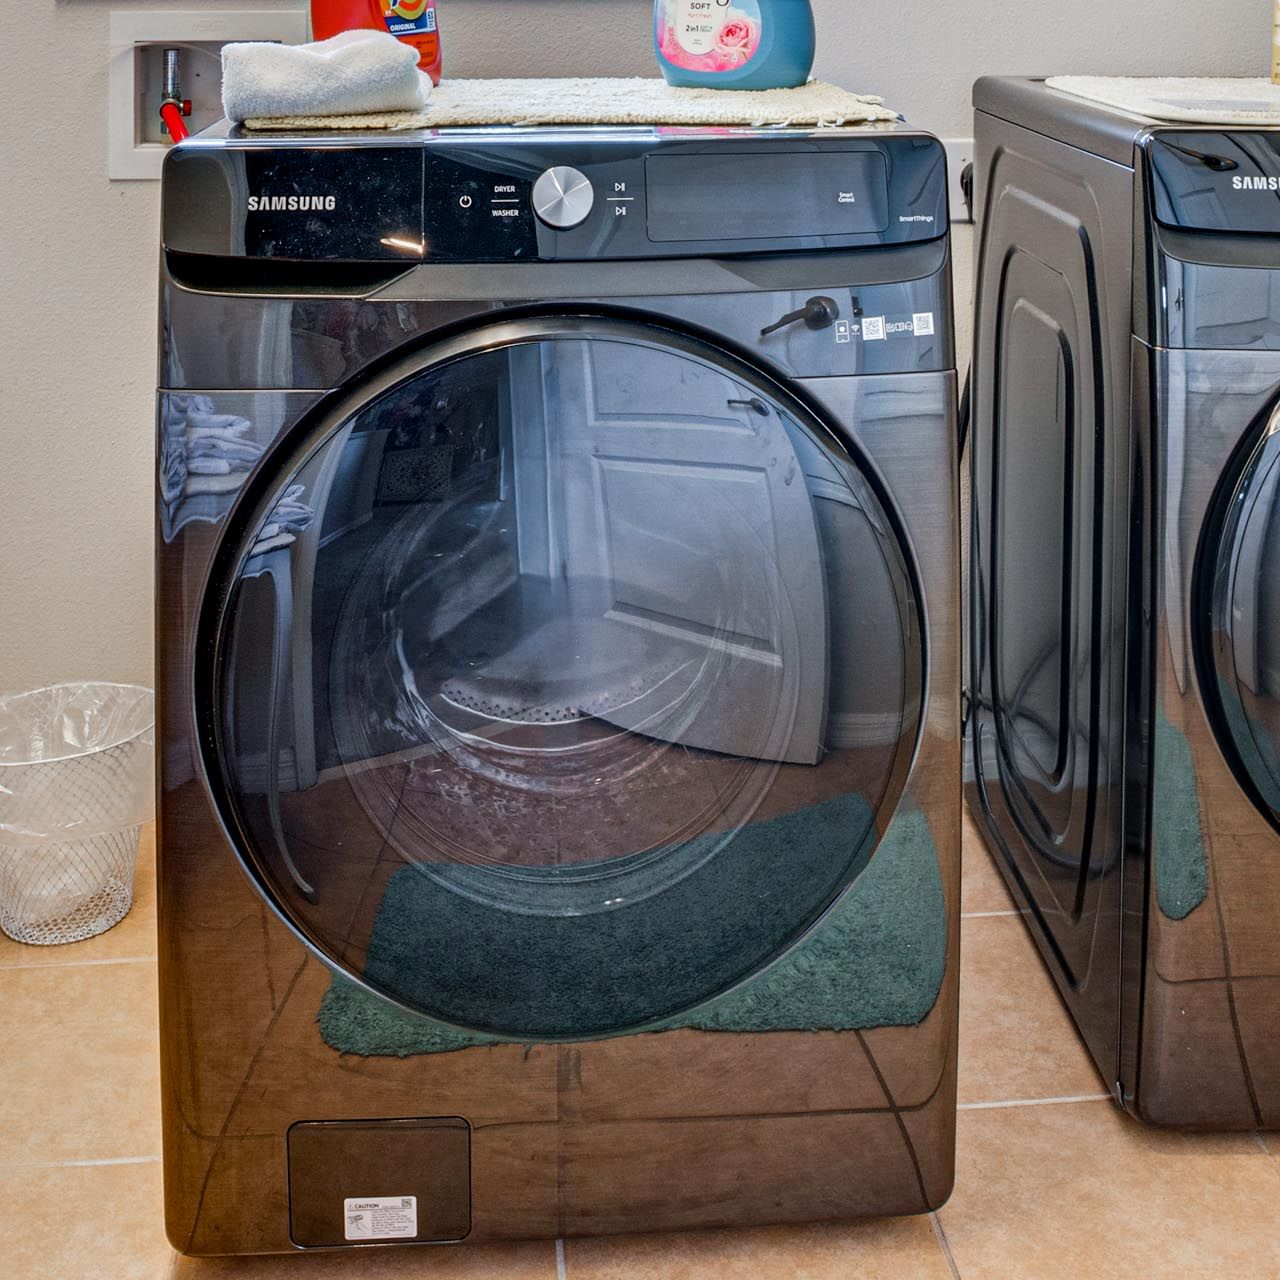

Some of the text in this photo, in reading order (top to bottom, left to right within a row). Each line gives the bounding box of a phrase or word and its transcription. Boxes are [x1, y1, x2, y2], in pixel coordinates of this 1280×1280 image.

[690, 2, 712, 10] SOFT
[389, 22, 417, 31] ORIGINAL
[247, 195, 336, 211] SAMSUNG
